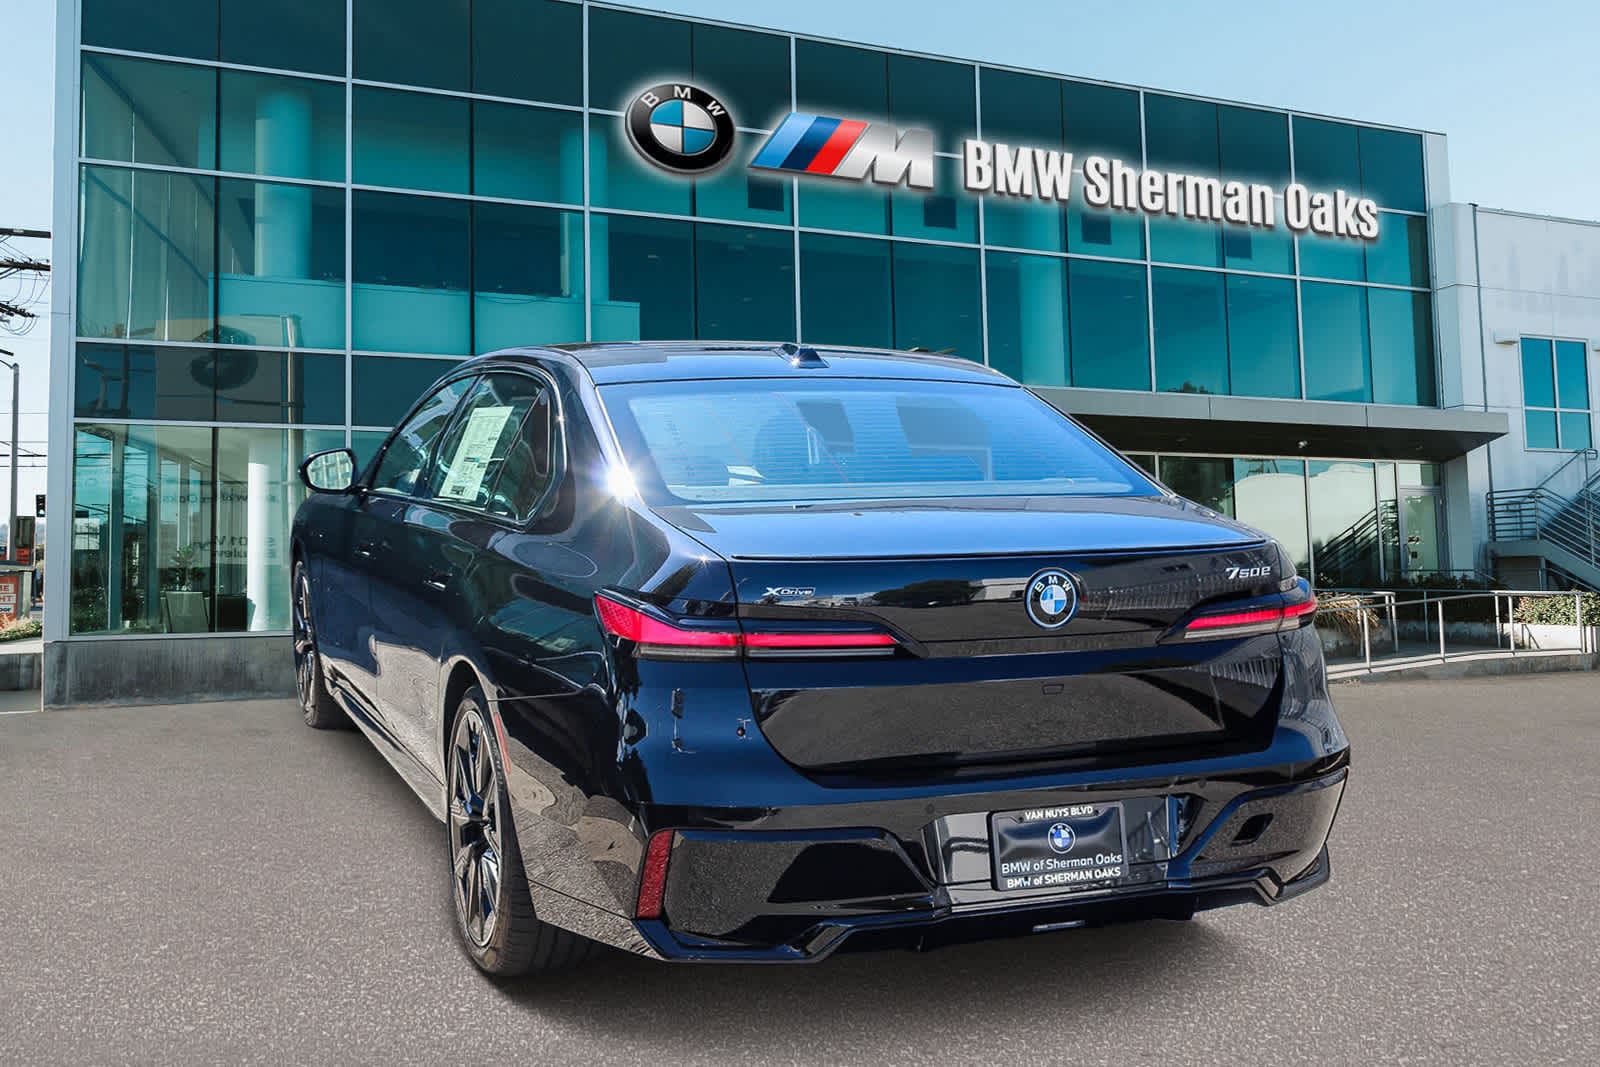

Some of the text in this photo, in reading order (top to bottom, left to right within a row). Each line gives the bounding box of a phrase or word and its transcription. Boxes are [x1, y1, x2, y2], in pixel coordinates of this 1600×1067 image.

[640, 84, 726, 118] BMW
[963, 139, 1379, 240] BMW Sherman Oaks
[1034, 575, 1072, 593] BMW
[1025, 805, 1094, 820] VAN NUYS BLVD
[1001, 852, 1123, 874] BMW of Sherman Oaks
[1007, 866, 1122, 889] BMW of SHERMAN OAKS
